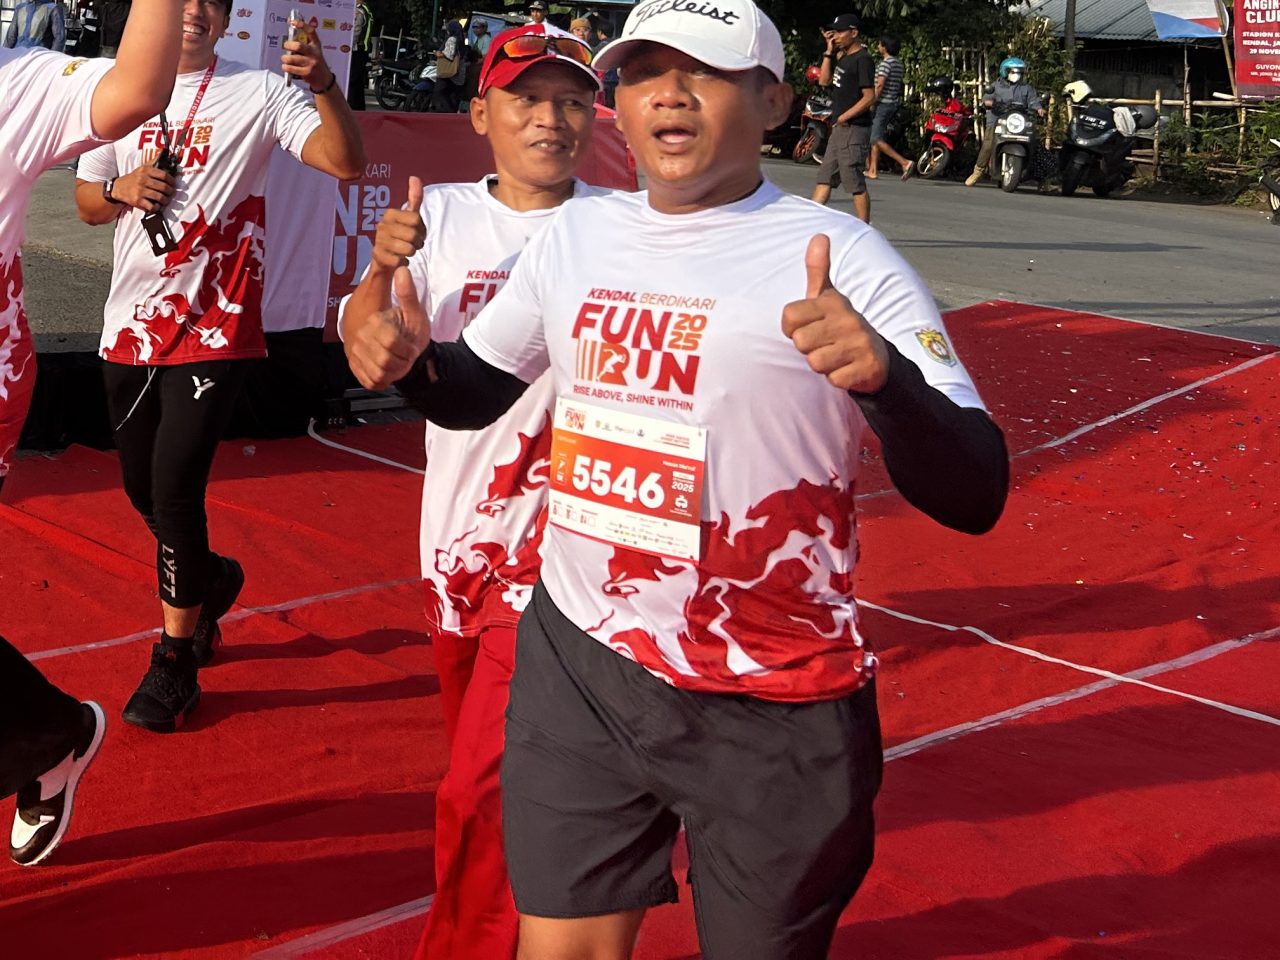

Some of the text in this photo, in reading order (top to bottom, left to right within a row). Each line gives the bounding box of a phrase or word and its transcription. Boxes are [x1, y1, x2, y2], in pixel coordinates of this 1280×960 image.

[187, 90, 204, 120] OFFICIAL
[143, 120, 173, 128] KENL
[138, 125, 213, 150] FUN 20
[193, 134, 211, 144] 25
[362, 185, 391, 208] 20
[587, 288, 717, 310] KENDAL BERDIKARI
[571, 302, 708, 351] FUN 20
[668, 331, 702, 351] 25
[594, 342, 701, 395] RUN
[573, 385, 694, 411] RISE ABOVE, SHINE WITHIN
[572, 454, 665, 509] 5546
[671, 480, 694, 493] 2025
[162, 543, 176, 598] LYFT
